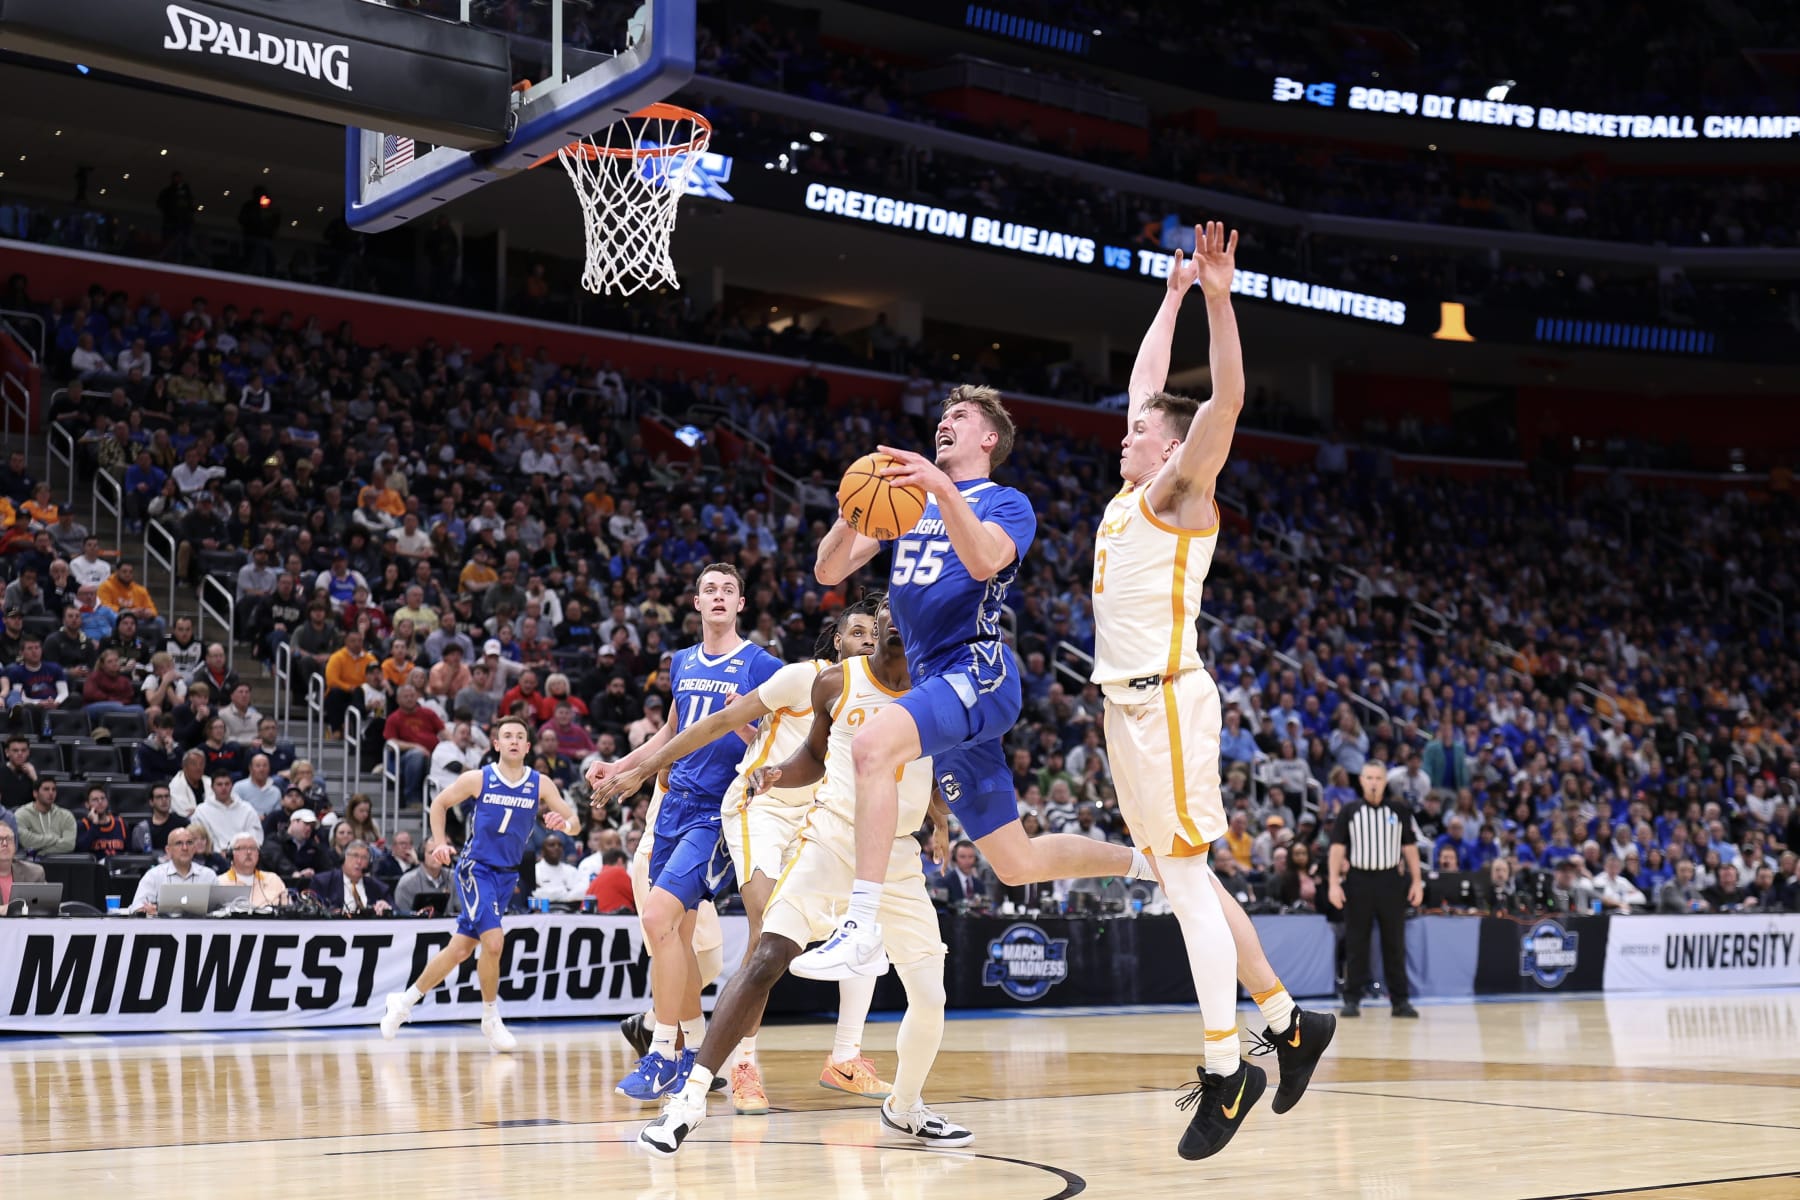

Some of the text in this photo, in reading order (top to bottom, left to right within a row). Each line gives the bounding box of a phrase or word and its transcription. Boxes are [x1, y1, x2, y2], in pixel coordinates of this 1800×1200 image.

[164, 4, 350, 90] SPALDING
[1348, 86, 1418, 115] 2024
[1421, 95, 1455, 119] DI
[1458, 99, 1535, 128] MEN'S
[1537, 107, 1698, 138] BASKETBALL
[805, 183, 967, 239] CREIGHTON
[971, 216, 1096, 264] BLUEJAYS
[1104, 246, 1132, 269] VS
[1271, 276, 1407, 325] VOLUNTEERS
[892, 539, 951, 586] 55
[677, 678, 739, 694] CREIGHTON
[684, 695, 714, 729] 11
[482, 793, 536, 809] CREIGHTON
[497, 808, 513, 834] 1
[1003, 944, 1045, 960] MARCH
[1008, 960, 1066, 976] MADNESS
[1665, 932, 1794, 969] UNIVERSITY
[10, 934, 393, 1016] MIDWEST
